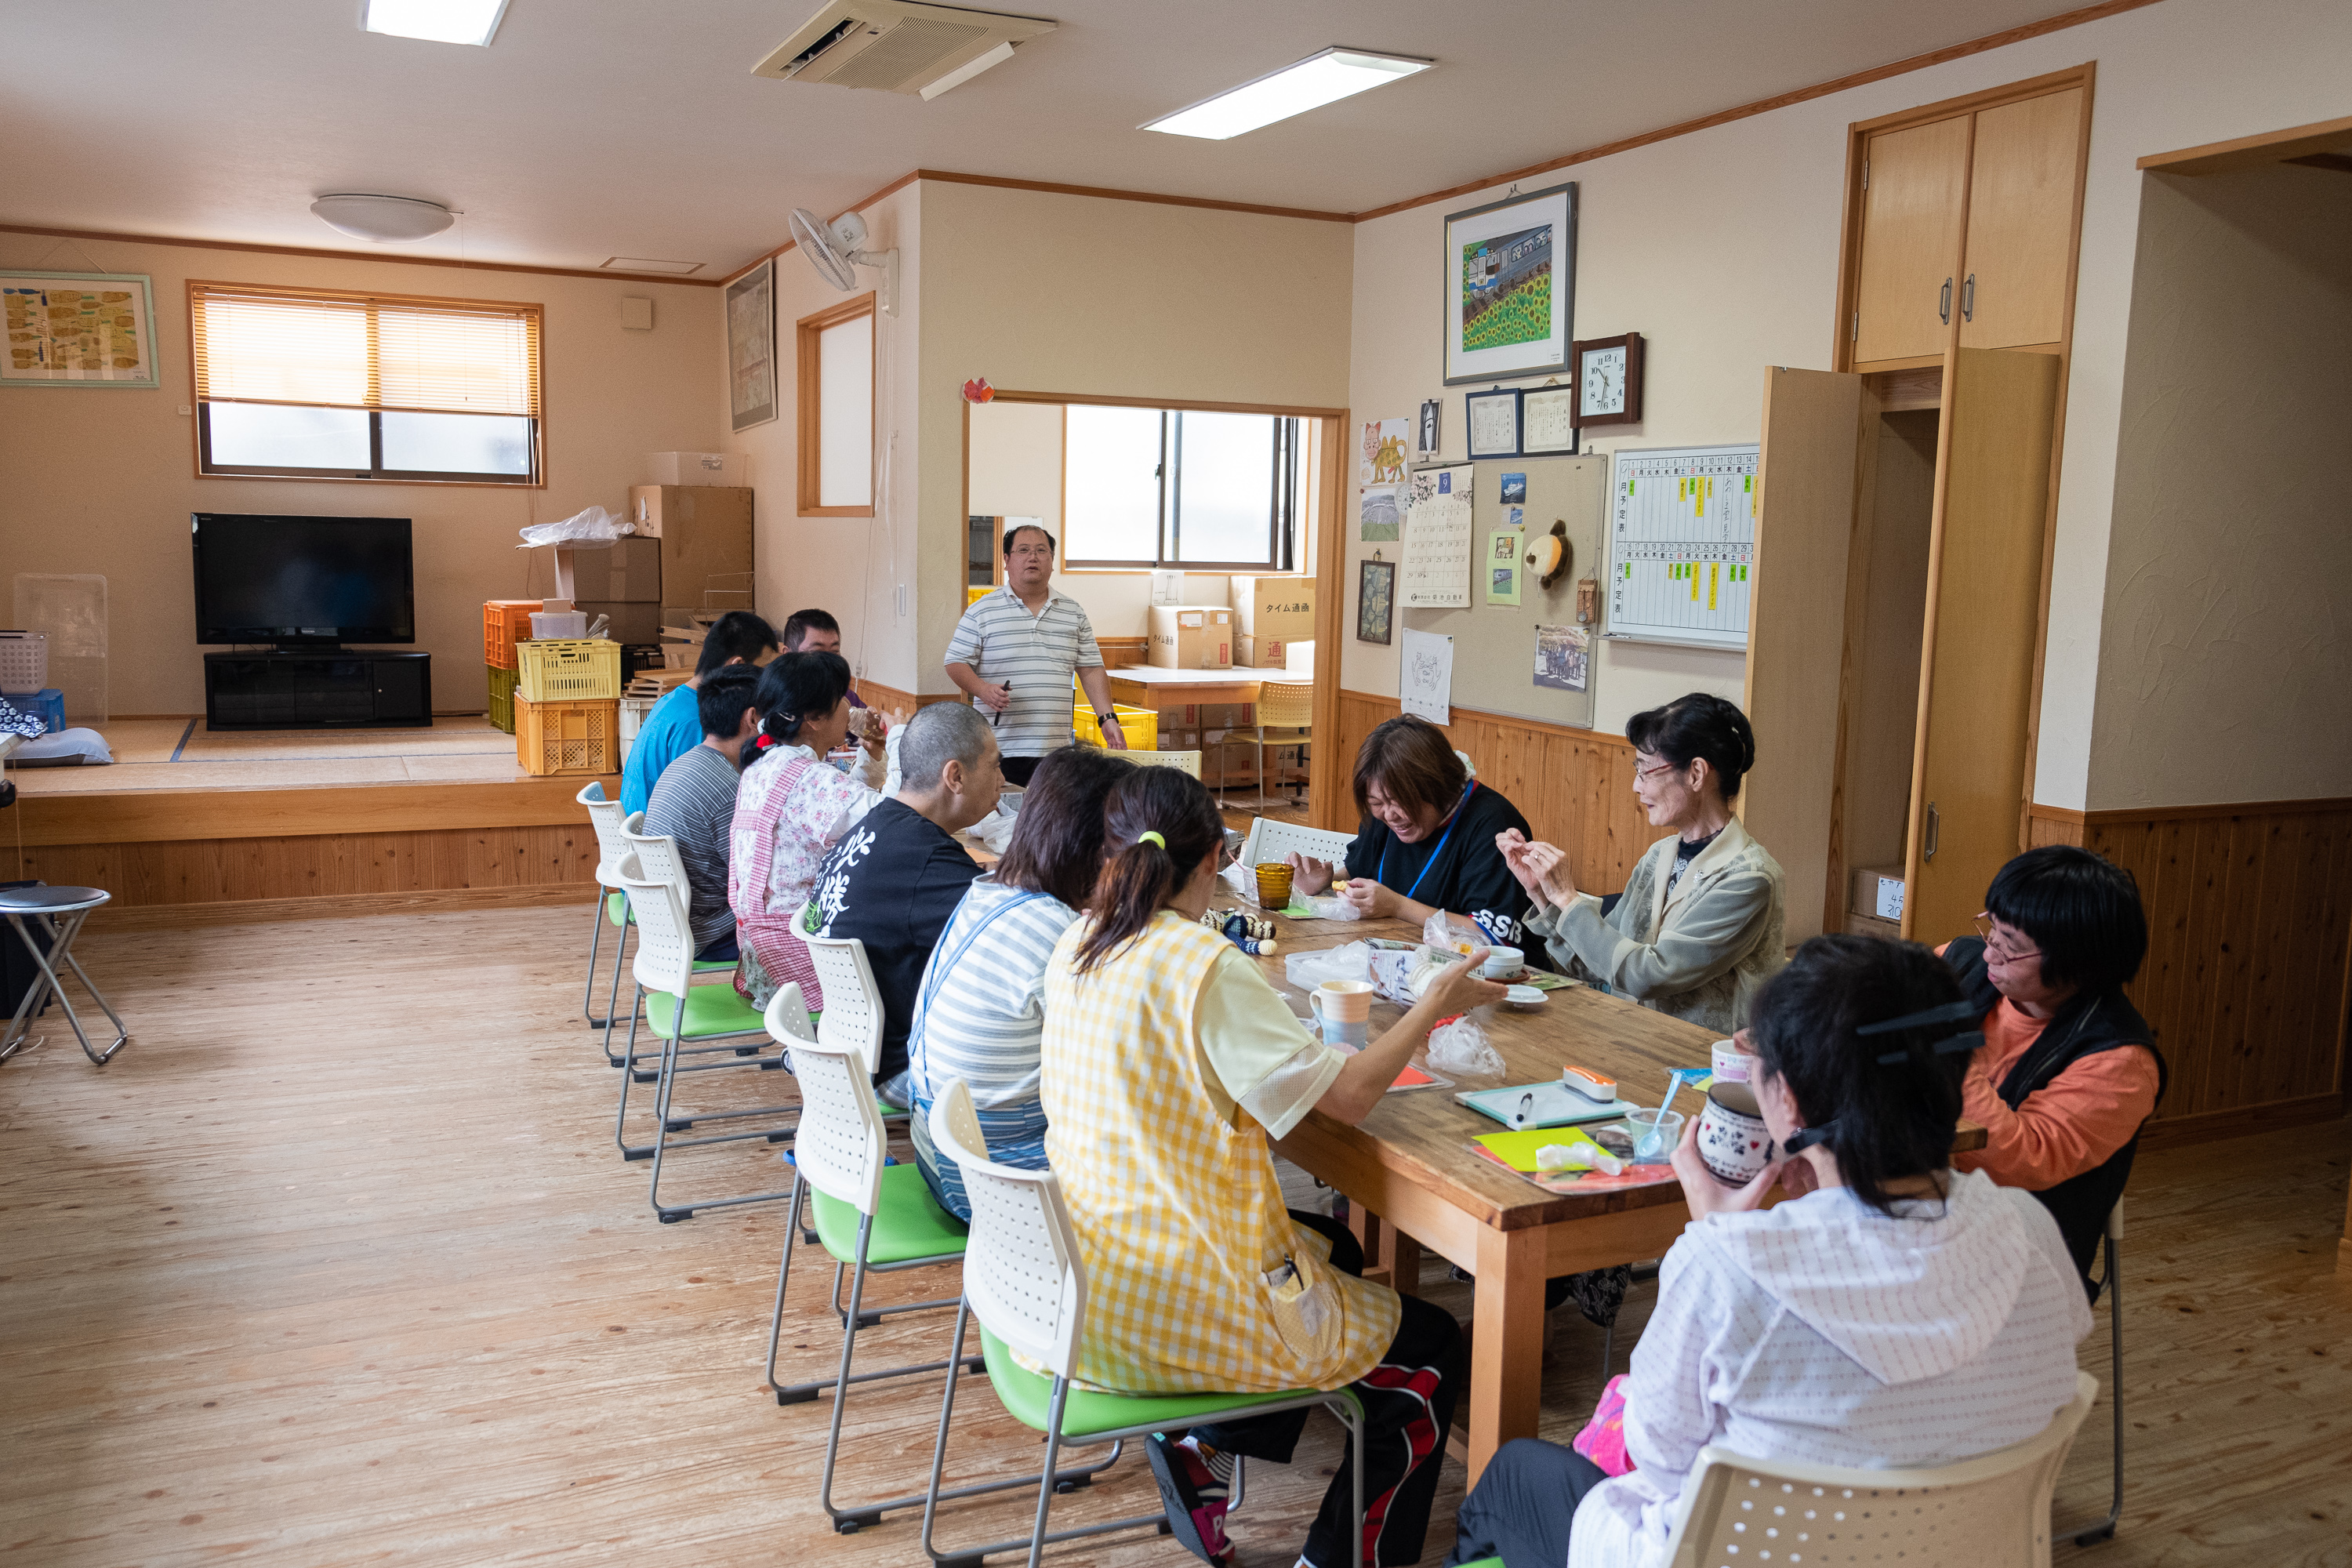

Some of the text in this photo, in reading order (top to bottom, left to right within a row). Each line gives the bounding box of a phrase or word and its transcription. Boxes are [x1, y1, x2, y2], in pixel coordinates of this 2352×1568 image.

[1443, 478, 1447, 488] 9
[1618, 482, 1627, 532] 月予定表
[1614, 563, 1623, 613] 月予定表
[1266, 603, 1309, 613] タイム通函
[1268, 641, 1282, 657] 通
